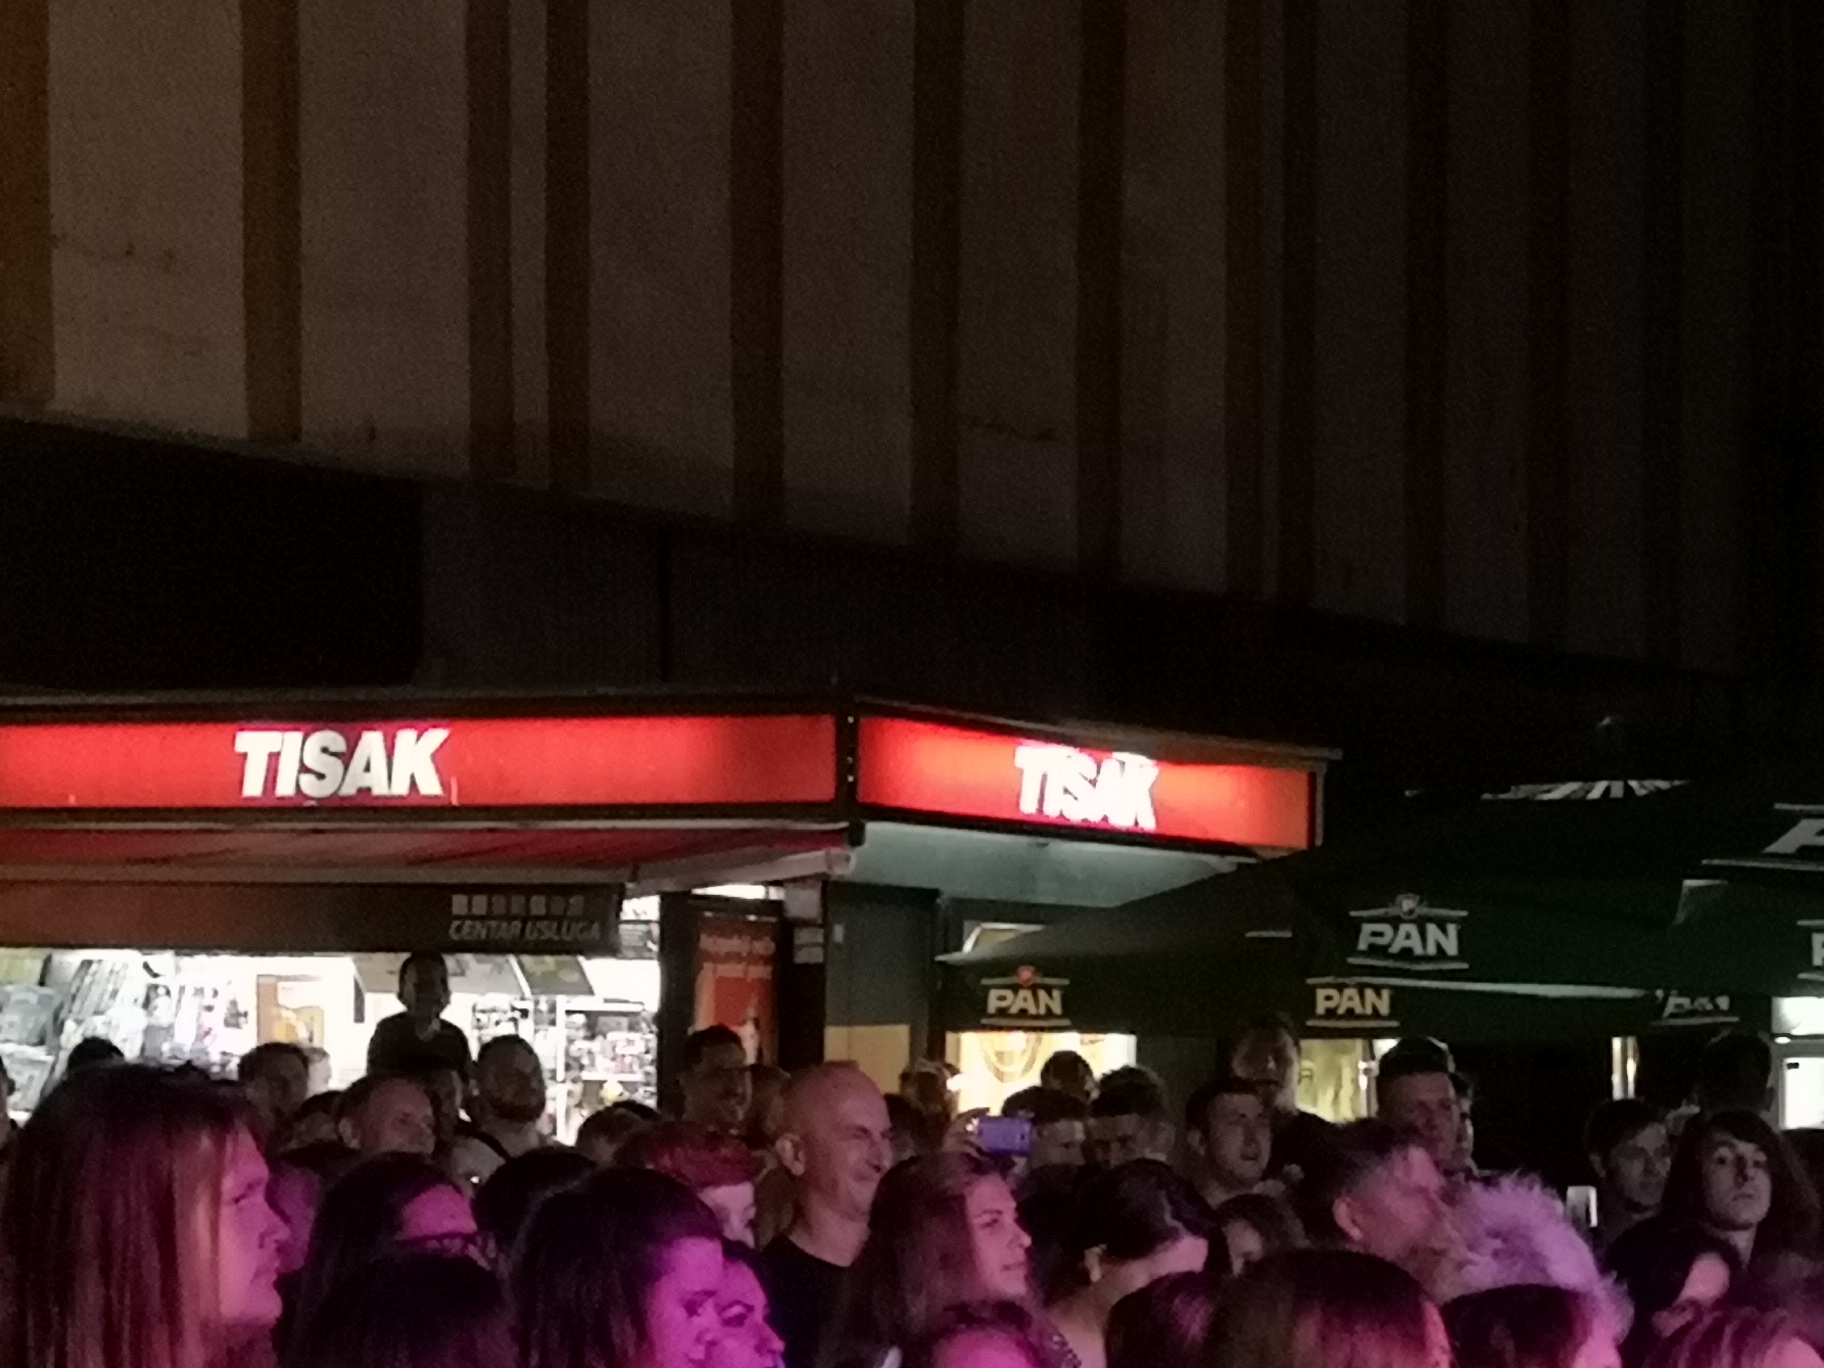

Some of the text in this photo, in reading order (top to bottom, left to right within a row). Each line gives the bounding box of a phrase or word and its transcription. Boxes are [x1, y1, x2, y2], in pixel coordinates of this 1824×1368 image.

[234, 728, 451, 798] TISAK
[1014, 745, 1161, 831] TISAK
[448, 919, 601, 941] CENTAR USLUGA
[1356, 923, 1460, 957] PAN
[986, 988, 1064, 1016] PAN
[1313, 987, 1391, 1017] PAN
